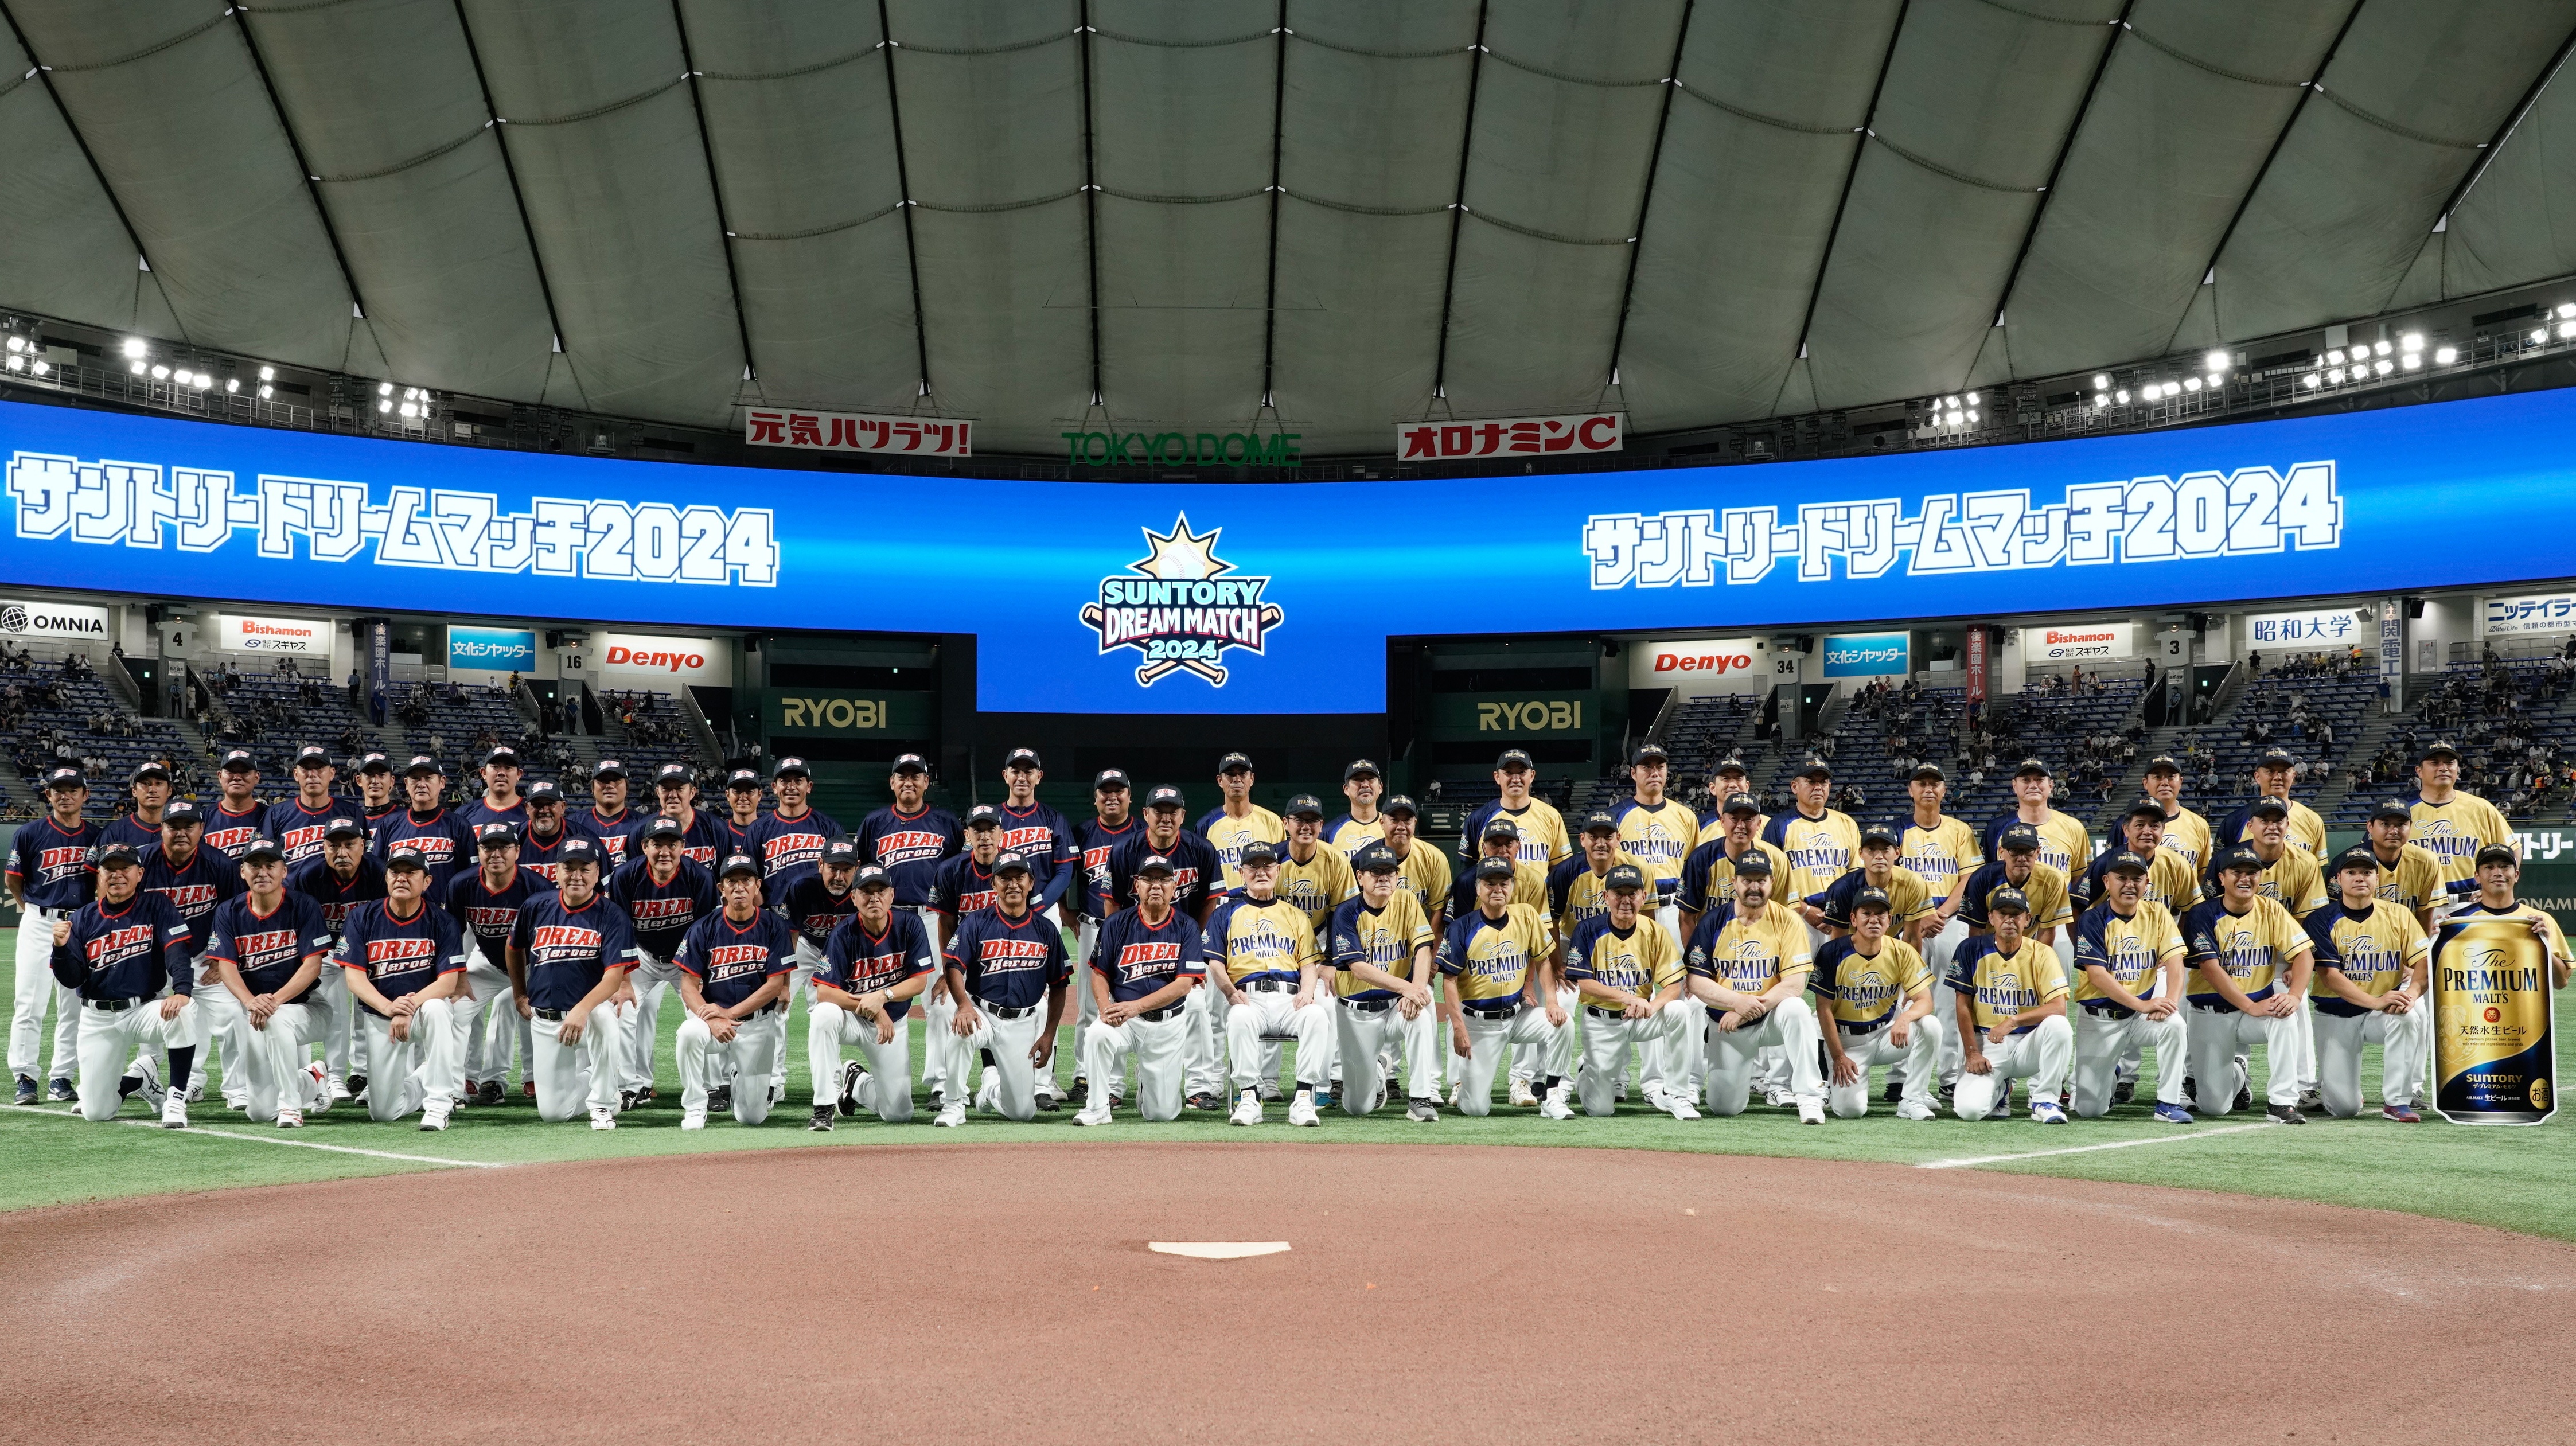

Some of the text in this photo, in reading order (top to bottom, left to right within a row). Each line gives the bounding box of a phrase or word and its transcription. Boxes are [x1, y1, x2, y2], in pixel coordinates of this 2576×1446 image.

[750, 412, 969, 454] 元気ハツラツ!
[1404, 416, 1616, 458] オロナミンC
[1061, 432, 1302, 467] TOKYO DOME
[7, 451, 780, 587] サントリードリームマッチ2024
[1583, 457, 2344, 590] サントリードリームマッチ2024
[1104, 581, 1261, 605] SUNTORY
[2488, 598, 2576, 622] ニッテイラ
[34, 615, 104, 633] OMNIA
[243, 620, 312, 637] Bishamon
[1105, 607, 1260, 647] DREAM MATCH
[2255, 615, 2352, 641] 昭和大学
[173, 632, 183, 647] 4
[272, 640, 306, 651] スギヤス
[2046, 630, 2114, 644] Bishamon
[1148, 640, 1217, 660] 2024
[2075, 646, 2109, 657] スギヤス
[2169, 640, 2180, 655] 3
[2381, 619, 2401, 676] 関電工
[375, 624, 386, 691] 後楽園ホール
[567, 655, 582, 669] 16
[606, 646, 705, 672] Denyo
[1654, 653, 1751, 675] Denyo
[1970, 630, 1982, 697] 後楽園ホール
[1777, 660, 1794, 674] 34
[781, 697, 886, 729] RYOBI
[1478, 700, 1581, 731] RYOBI
[1298, 798, 1318, 806] PREMIUM
[1635, 823, 1671, 839] The
[2415, 819, 2460, 836] The
[765, 834, 825, 860] DREAM
[878, 833, 945, 855] DREAM
[1800, 832, 1838, 847] The
[1911, 841, 1947, 855] The
[884, 848, 936, 867] Heroes
[1621, 840, 1685, 859] PREMIUM
[774, 852, 821, 872] Heroes
[1813, 866, 1836, 876] MALT'S
[1284, 879, 1318, 894] The
[2515, 898, 2576, 910] ONAMI
[86, 924, 153, 963] DREAM
[535, 927, 601, 948] DREAM
[1362, 929, 1393, 946] The
[2112, 937, 2145, 951] The
[2224, 931, 2258, 947] The
[2341, 936, 2381, 951] The
[540, 947, 597, 964] Heroes
[983, 940, 1048, 958] DREAM
[1483, 941, 1519, 955] The
[1729, 940, 1768, 957] The
[245, 947, 298, 968] Heroes
[988, 958, 1040, 973] Heroes
[1468, 950, 1530, 975] PREMIUM
[1604, 952, 1640, 968] The
[2462, 948, 2515, 968] The
[1492, 973, 1516, 983] MALT'S
[1849, 972, 1887, 985] The
[1988, 971, 2022, 988] The
[2115, 972, 2140, 981] MALT'S
[2443, 967, 2539, 992] PREMIUM
[1732, 980, 1762, 991] MALT'S
[1835, 983, 1899, 1000] PREMIUM
[1855, 999, 1877, 1009] MALT'S
[2473, 992, 2509, 1004] MALT'S
[1993, 1007, 2018, 1015] MALT'S
[2459, 1025, 2527, 1036] 天然水生ビール
[2532, 1086, 2549, 1102] お酒
